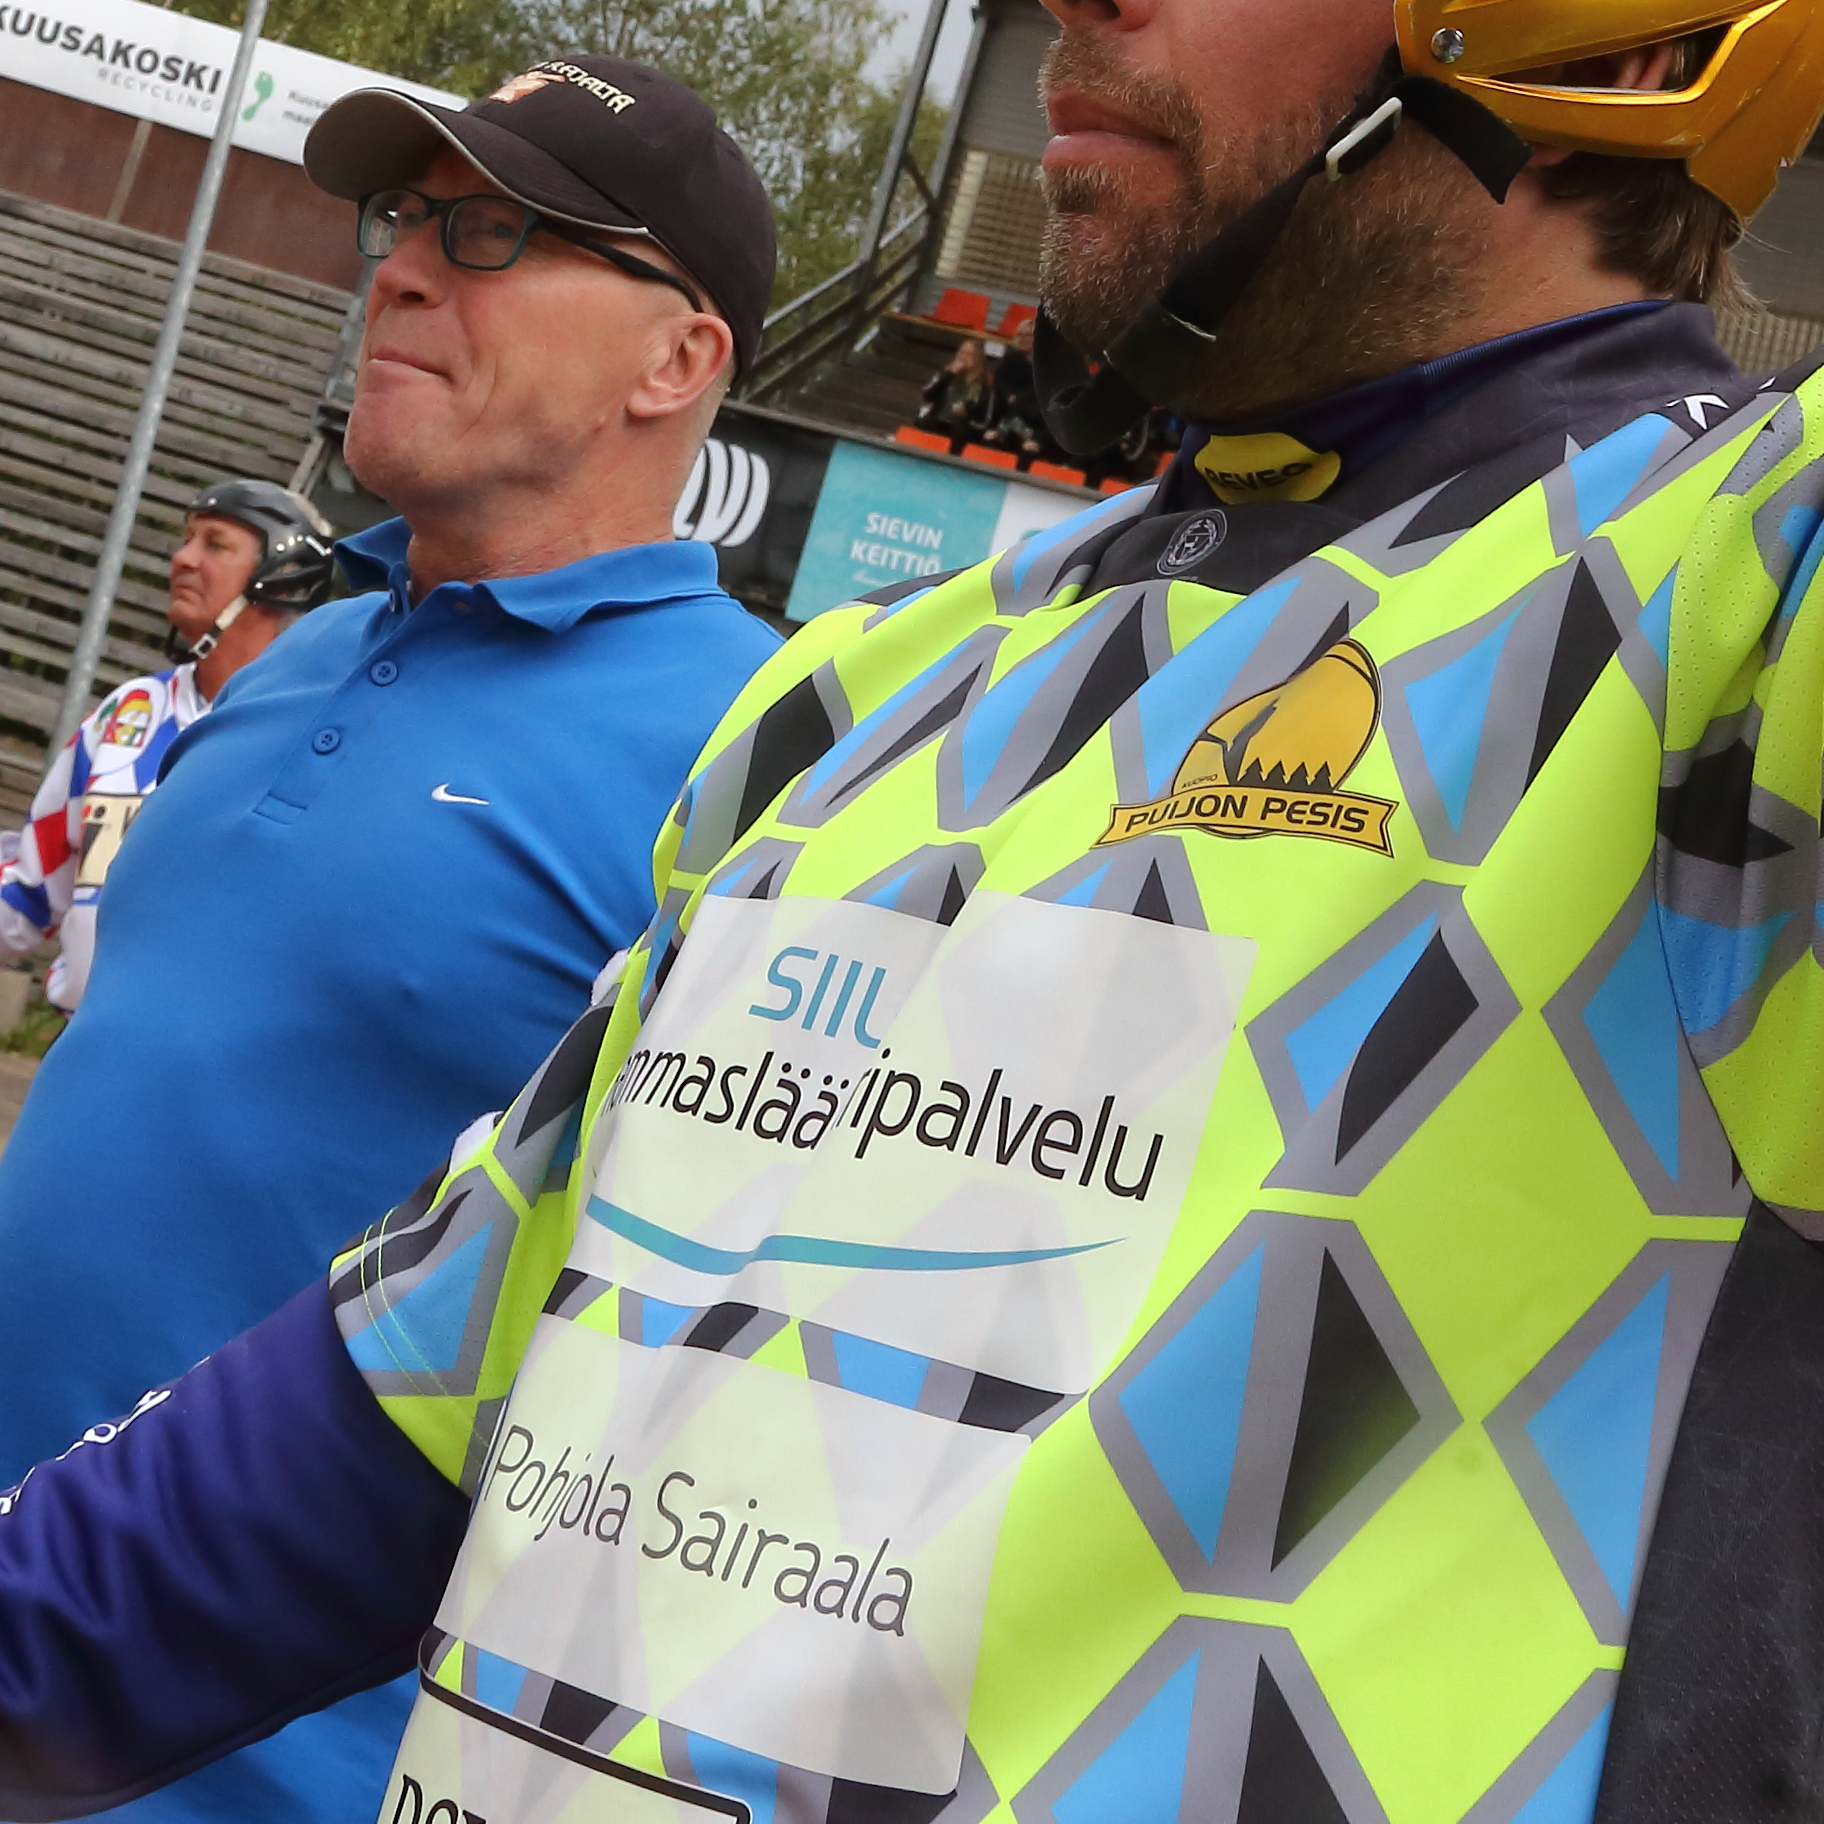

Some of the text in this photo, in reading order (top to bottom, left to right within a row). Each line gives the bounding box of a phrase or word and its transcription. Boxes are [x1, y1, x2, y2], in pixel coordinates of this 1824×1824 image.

[96, 67, 215, 114] RECYCLING
[672, 438, 771, 547] LVI
[864, 510, 945, 550] SIEVIN
[1124, 794, 1370, 834] PUIJON PESIS
[483, 1423, 915, 1638] Pohjola Sairaala
